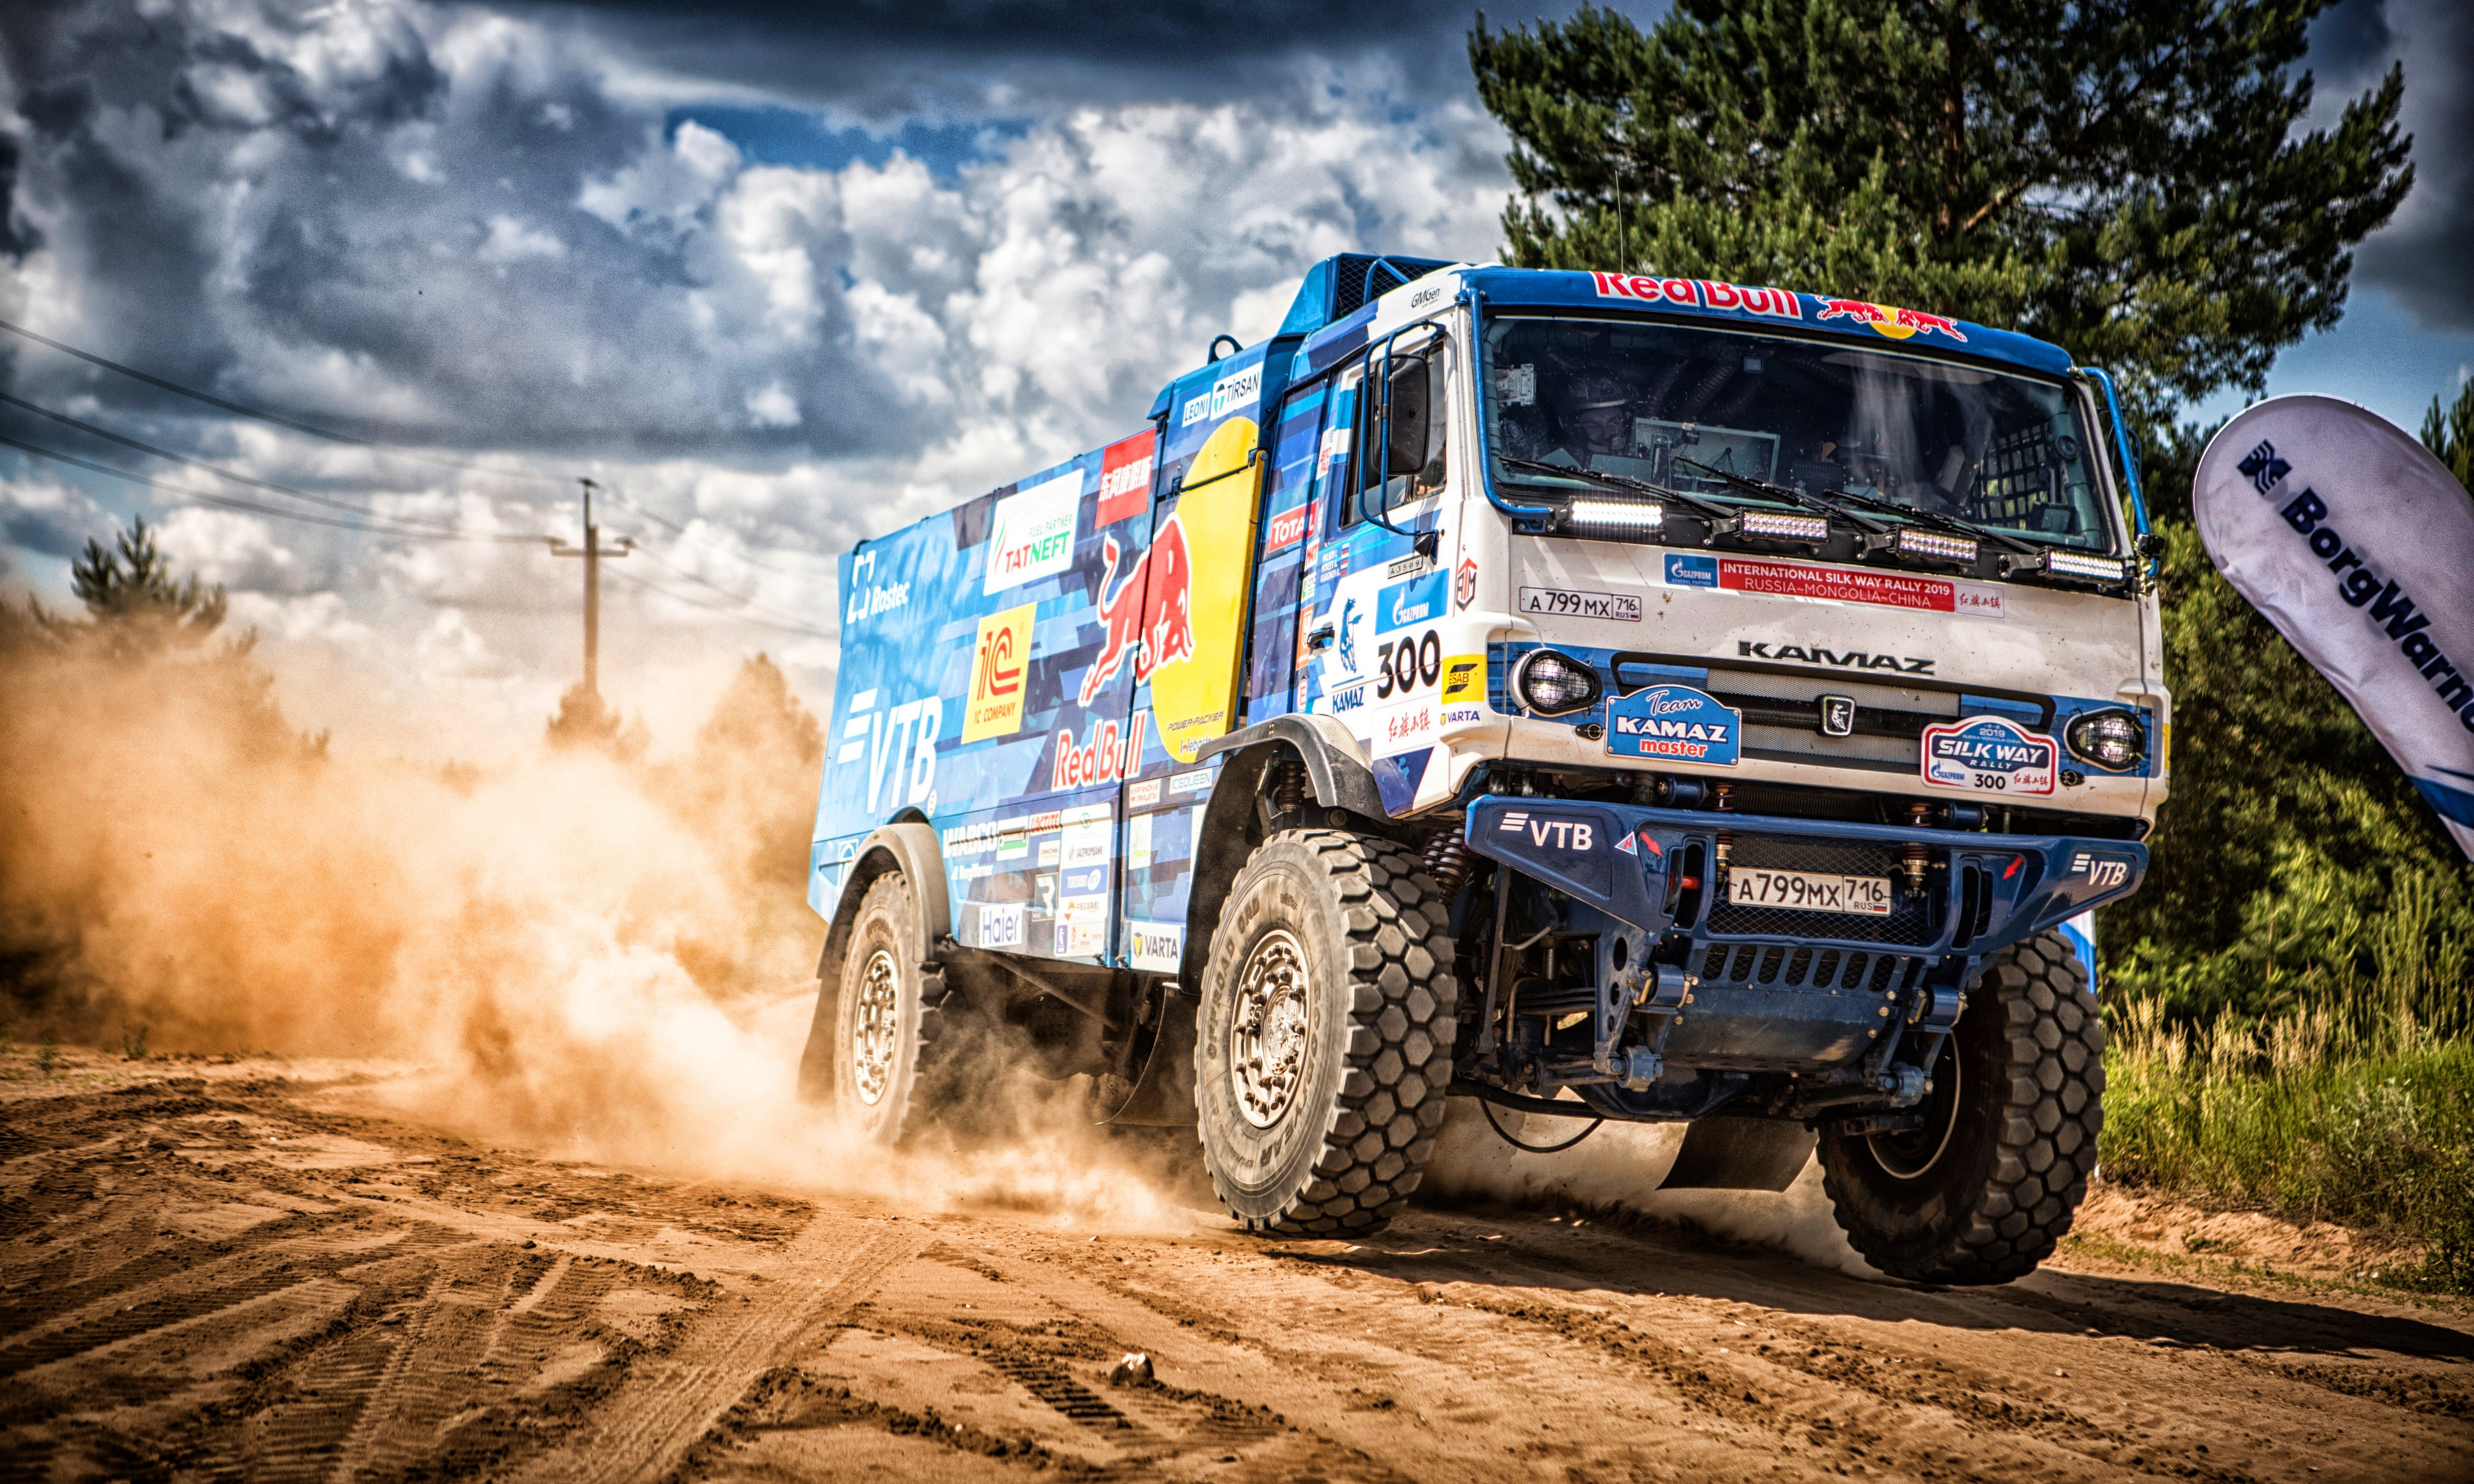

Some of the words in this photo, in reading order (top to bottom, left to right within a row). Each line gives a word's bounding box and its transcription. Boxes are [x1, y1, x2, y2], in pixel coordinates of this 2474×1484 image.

[1412, 287, 1440, 308] GMGen
[1592, 271, 1698, 306] Red
[1699, 280, 1801, 319] Bull
[1185, 398, 1209, 421] LEONI
[1029, 525, 1043, 538] FUEL
[1045, 514, 1072, 533] PARTNER
[1273, 513, 1314, 544] TOTAL
[1006, 530, 1070, 573] TATNEFT
[1682, 571, 1712, 580] GAZPROM
[1723, 563, 1823, 582] INTERNATIONAL
[1826, 573, 1852, 585] SILK
[1854, 576, 1881, 588] WAY
[1885, 579, 1921, 592] RALLY
[1924, 583, 1951, 596] 2019
[870, 581, 910, 615] Rostec
[1545, 592, 1581, 613] 799
[1616, 598, 1636, 610] 716
[1402, 602, 1429, 624] GAZPROM
[1377, 629, 1440, 699] 300
[1738, 640, 1935, 676] KAMAZ
[1448, 673, 1469, 685] ESAB
[983, 701, 1016, 722] COMPANY
[1332, 686, 1364, 715] KAMAZ
[1646, 690, 1703, 715] Team
[1448, 711, 1480, 723] VARTA
[1617, 716, 1728, 742] KAMAZ
[1979, 728, 2006, 738] 2019
[867, 696, 943, 814] VTB
[1052, 721, 1102, 790] Red
[1097, 711, 1147, 783] Bull
[1641, 740, 1708, 757] master
[1937, 740, 1994, 759] SILK
[1996, 744, 2045, 764] WAY
[1940, 771, 1965, 781] GAZPROM
[1969, 760, 2013, 769] RALLY
[1172, 772, 1211, 790] ICEQUEEN
[1974, 774, 2006, 790] 300
[1030, 813, 1059, 834] LOCTITE
[1529, 820, 1592, 851] VTB
[943, 821, 997, 859] WABCO
[1076, 845, 1103, 858] GAZPROMBANK
[2088, 861, 2128, 886] VTB
[1845, 879, 1884, 902] 716
[1854, 902, 1873, 911] RUS
[983, 909, 1019, 945] Haier
[1145, 934, 1178, 960] VARTA
